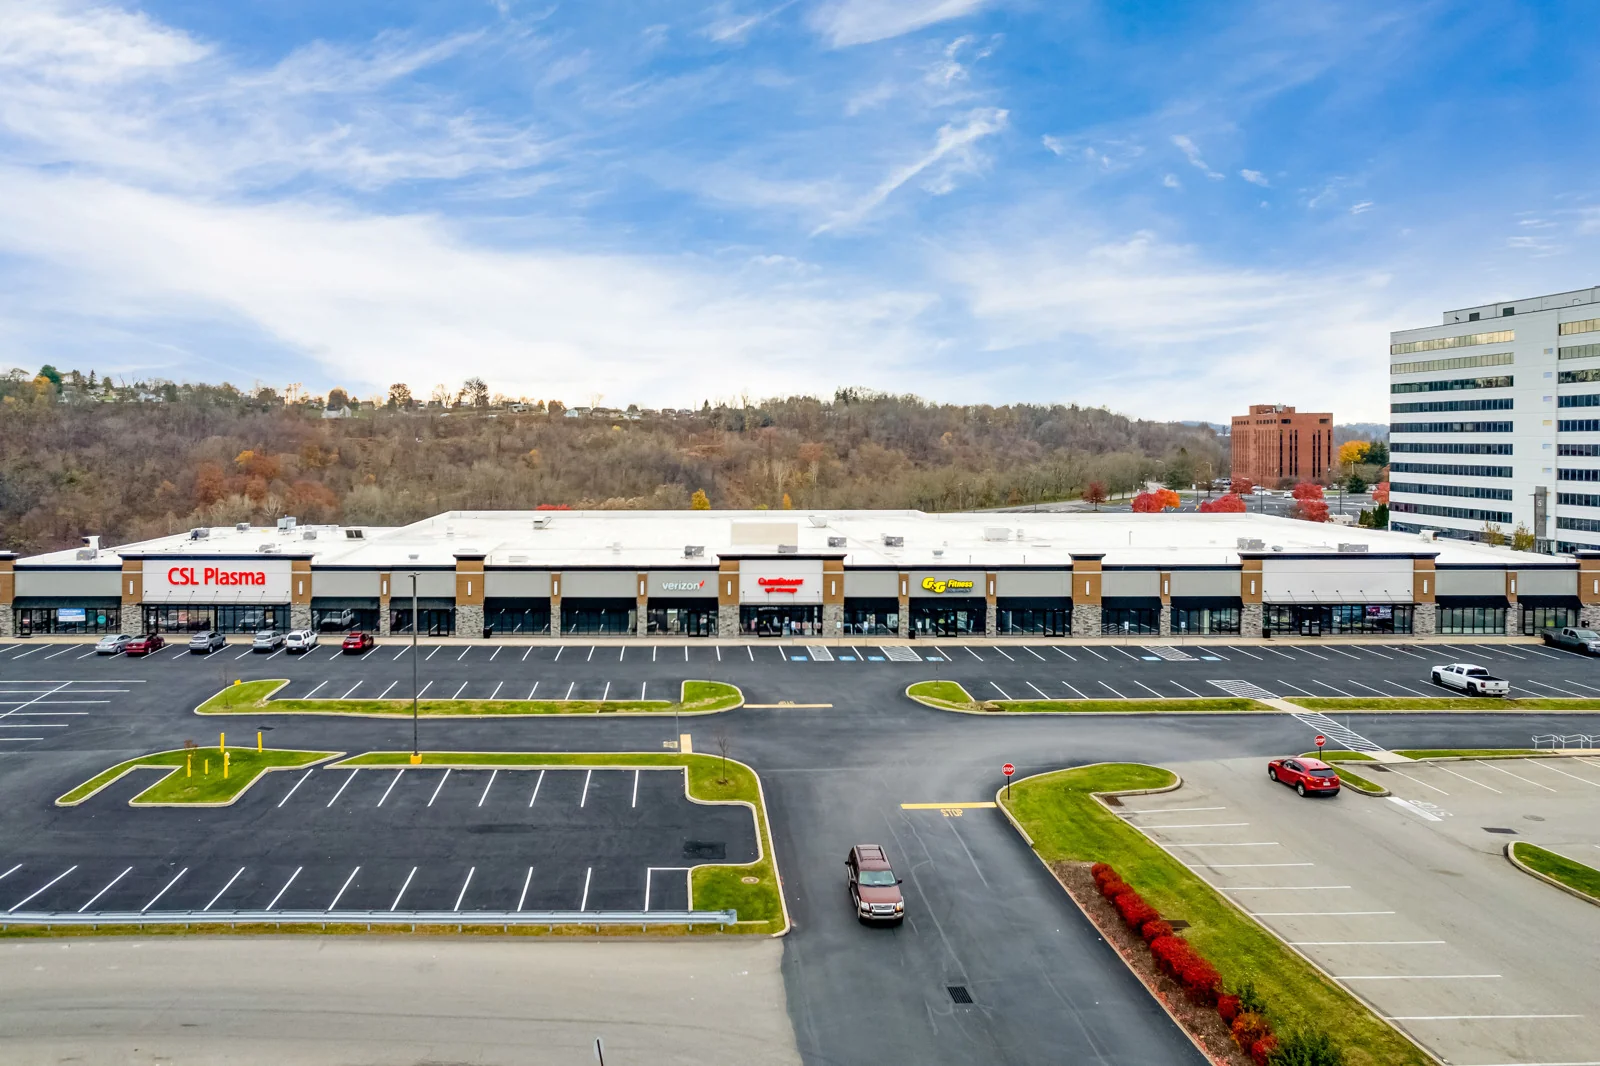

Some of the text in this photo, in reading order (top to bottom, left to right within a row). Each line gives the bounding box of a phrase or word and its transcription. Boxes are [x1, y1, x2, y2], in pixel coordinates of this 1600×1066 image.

[167, 567, 266, 586] CSL Plasma
[662, 580, 700, 590] verizon
[947, 579, 974, 588] Fitness
[940, 808, 963, 817] STOP
